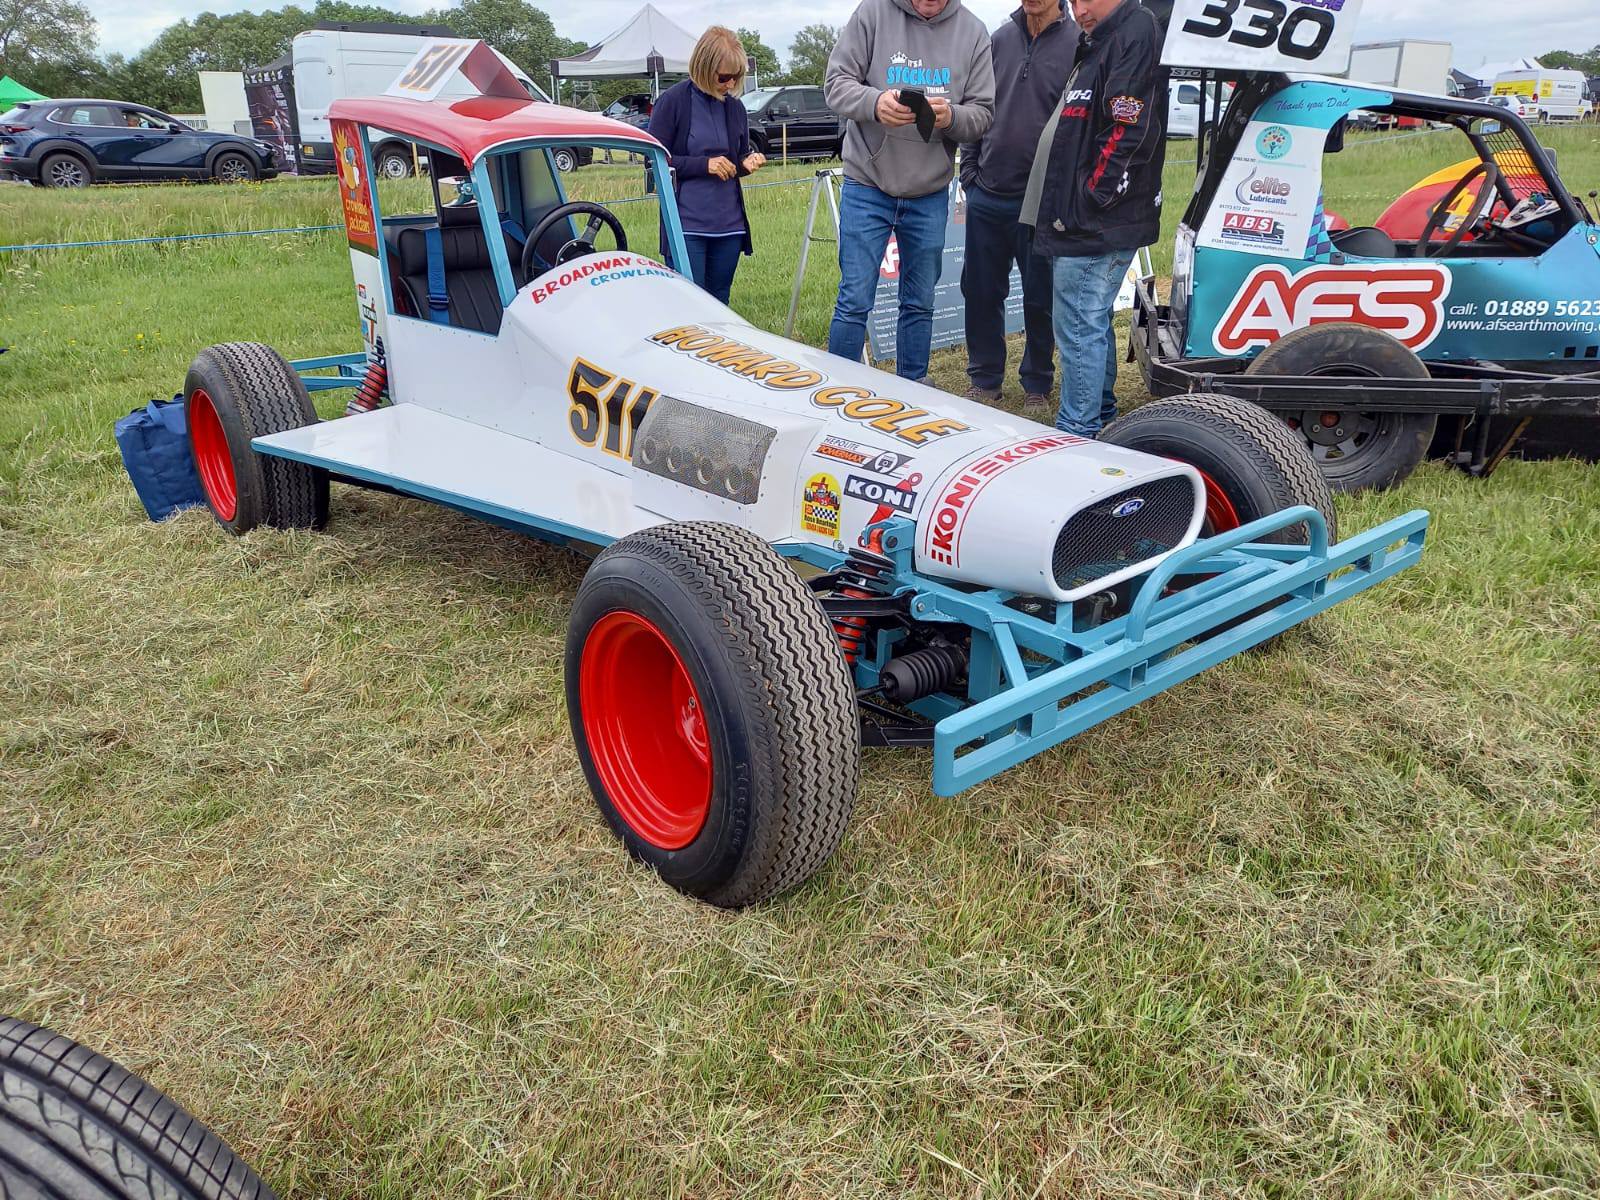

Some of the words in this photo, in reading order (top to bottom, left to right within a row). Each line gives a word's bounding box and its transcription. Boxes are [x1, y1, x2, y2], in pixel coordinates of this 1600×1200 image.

[1182, 0, 1335, 60] 330
[886, 65, 951, 86] STOCKCAR
[1274, 99, 1306, 111] Thank
[1307, 102, 1324, 111] you
[1326, 97, 1350, 108] Dad
[1250, 177, 1291, 196] elite
[1249, 194, 1288, 205] Lubricants
[1225, 213, 1271, 231] ABS
[531, 257, 632, 304] BROADWAY
[590, 268, 676, 287] CROWLAND
[1215, 266, 1450, 353] AFS
[1450, 303, 1478, 315] call:
[1484, 300, 1549, 316] 01889
[1447, 318, 1600, 334] www.afsearthmoving.
[651, 325, 824, 390] HOWARD
[813, 386, 972, 445] COLE
[567, 356, 661, 462] 511
[823, 435, 861, 450] HEPOLITE
[816, 446, 866, 465] POWERMAX
[847, 478, 913, 509] KONI
[932, 475, 981, 551] KONI
[994, 438, 1058, 462] KONI
